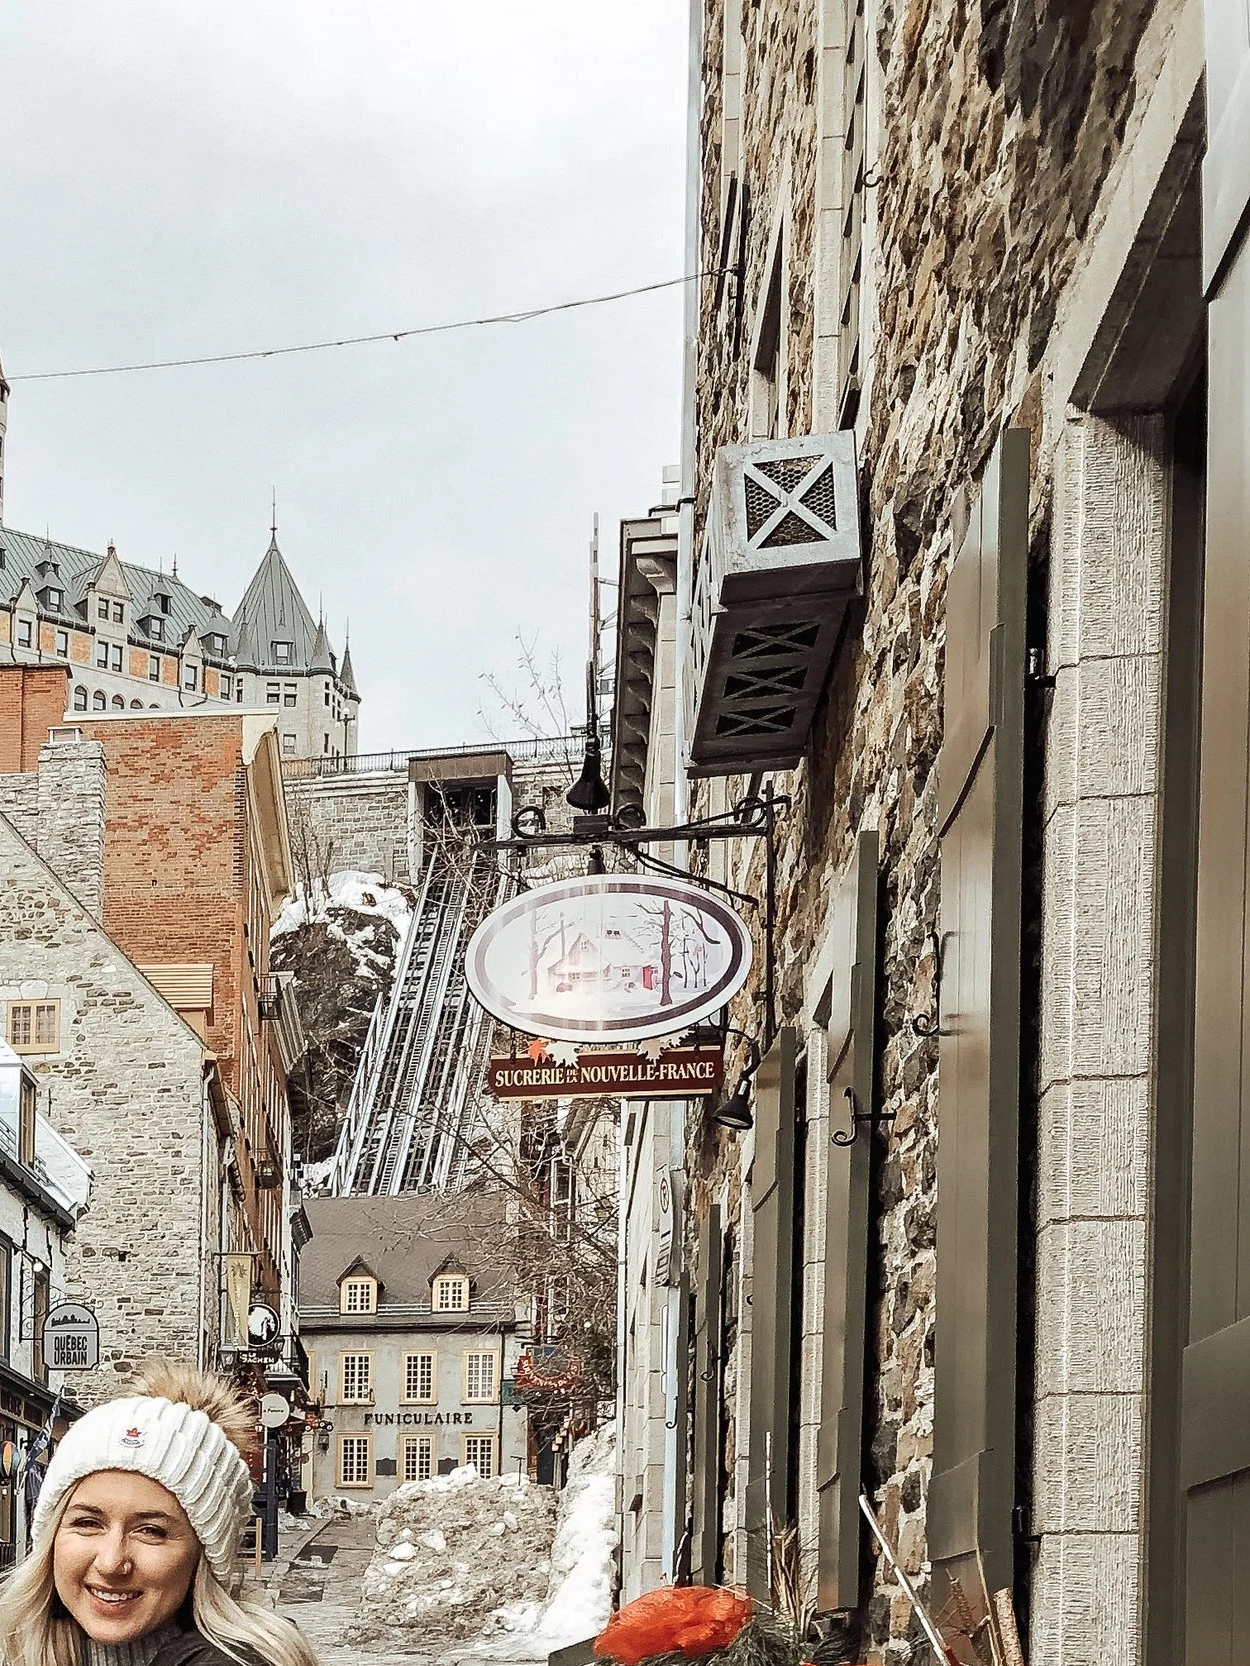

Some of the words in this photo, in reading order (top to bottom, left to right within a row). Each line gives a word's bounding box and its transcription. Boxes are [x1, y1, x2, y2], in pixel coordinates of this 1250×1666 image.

[494, 1068, 564, 1087] SUCRERIE
[580, 1062, 715, 1083] NOUVELLE-FRANCE
[54, 1351, 88, 1365] URBAIN
[364, 1412, 473, 1425] FUNICULAIRE
